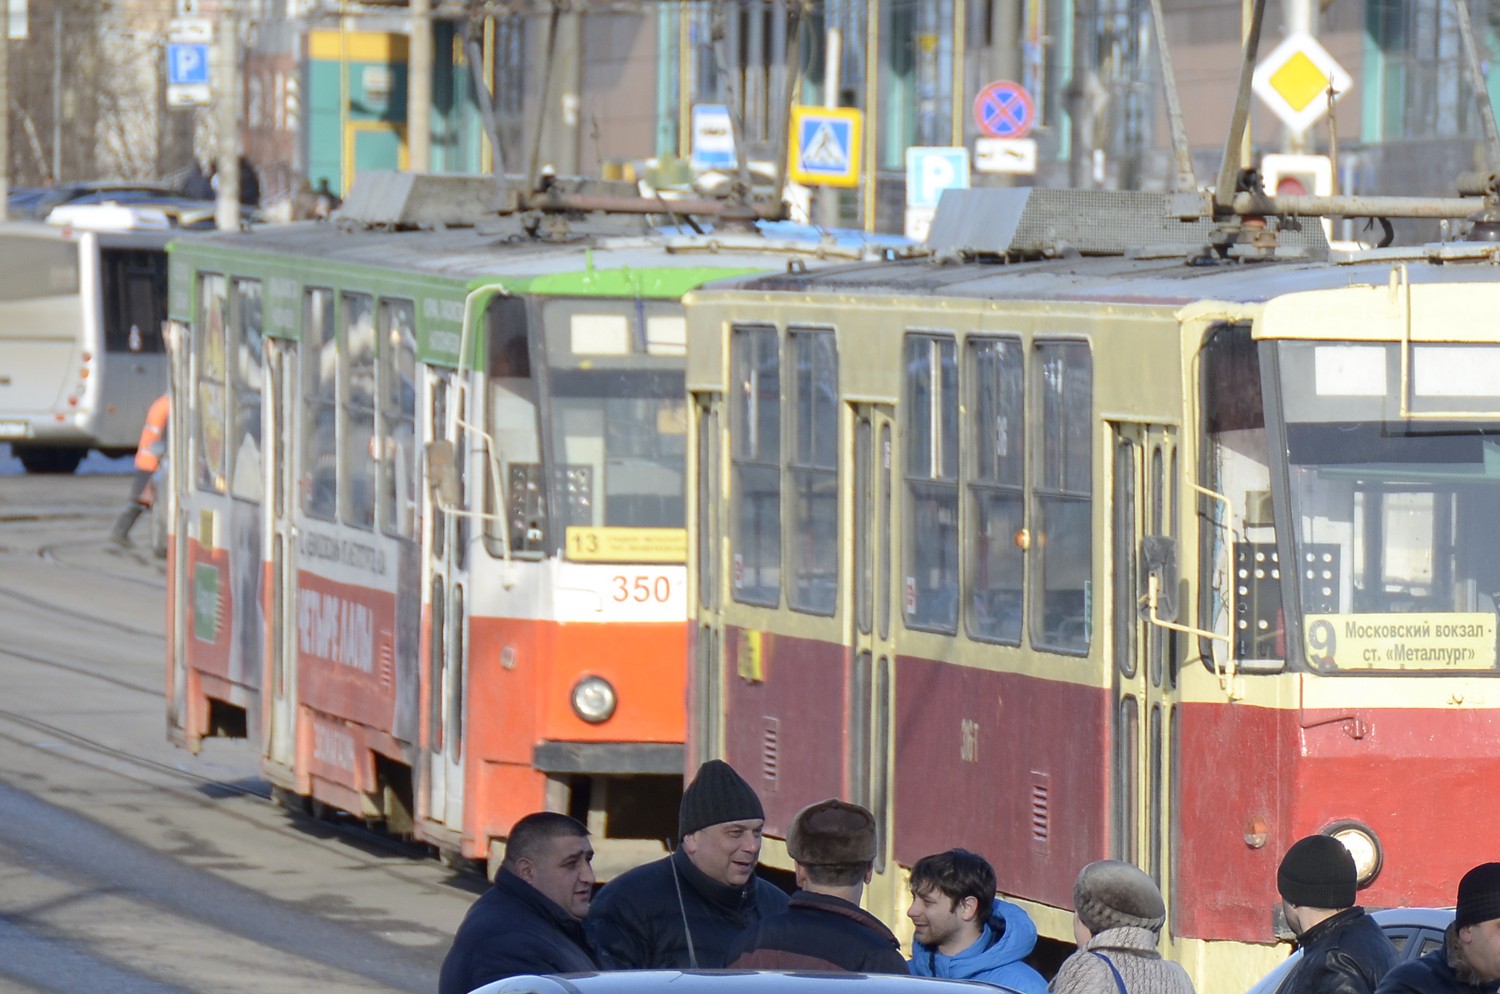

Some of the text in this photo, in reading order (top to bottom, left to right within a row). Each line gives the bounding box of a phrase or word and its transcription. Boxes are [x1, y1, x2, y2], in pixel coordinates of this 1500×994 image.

[922, 155, 954, 204] P
[573, 533, 599, 553] 13
[612, 575, 670, 603] 350
[1345, 620, 1484, 638] Московский вокзал
[1308, 618, 1338, 669] 9
[1362, 643, 1476, 665] ст. «Металлург»
